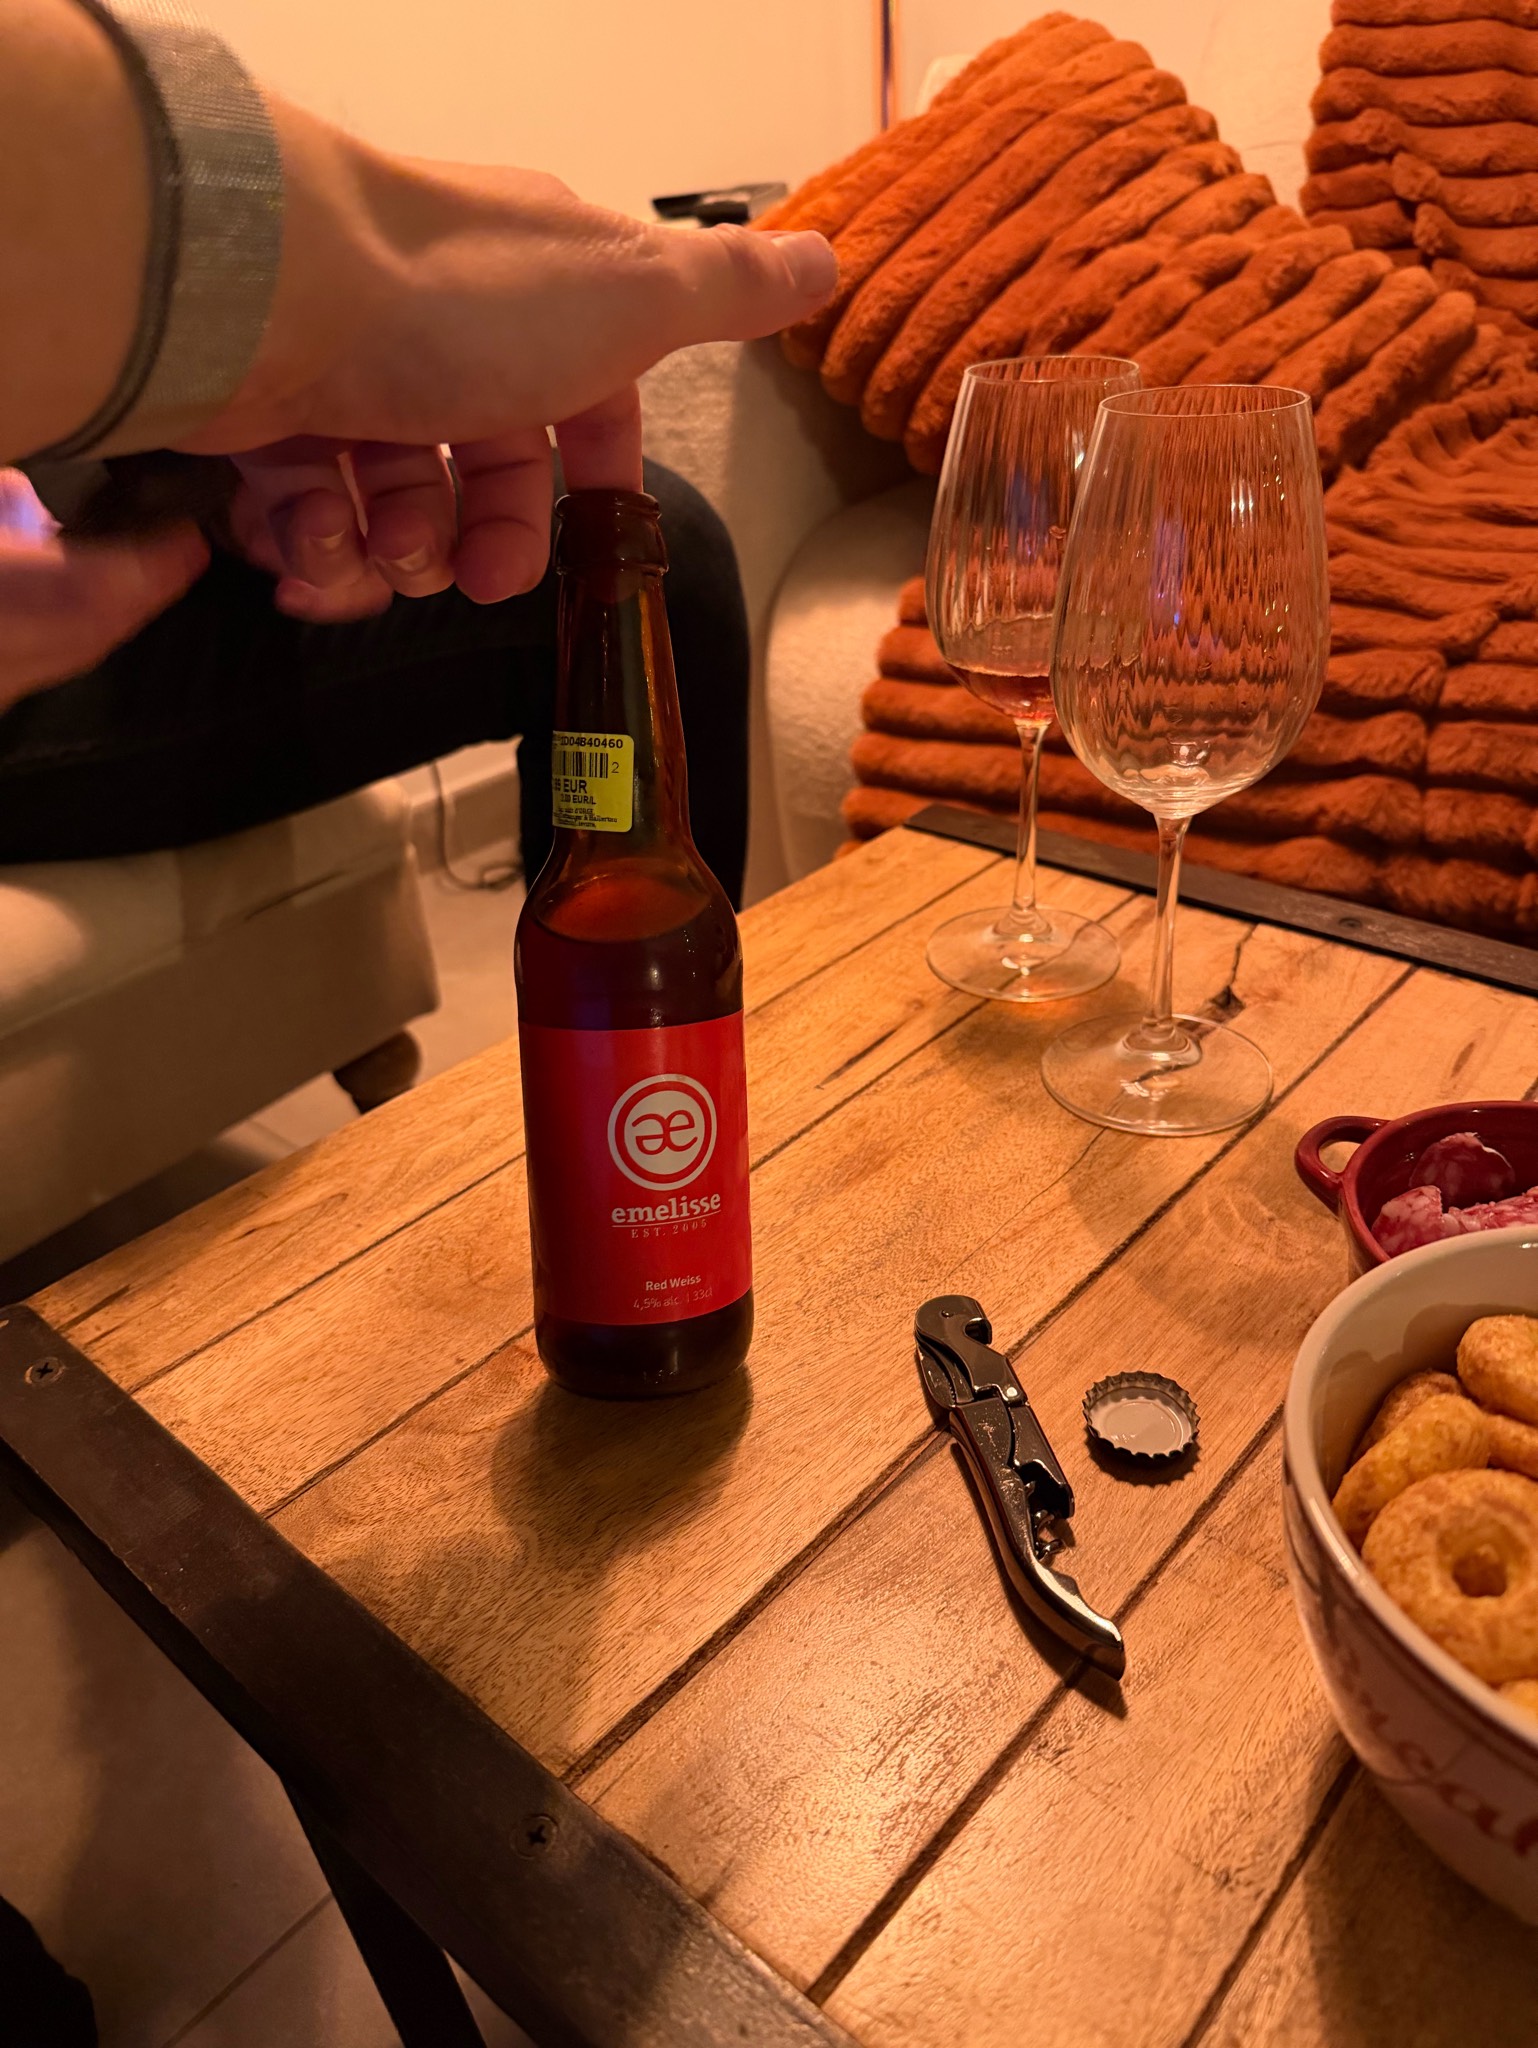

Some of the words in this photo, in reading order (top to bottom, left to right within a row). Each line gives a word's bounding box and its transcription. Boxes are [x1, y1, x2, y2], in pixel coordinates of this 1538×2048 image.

[611, 761, 620, 774] 2
[563, 778, 587, 794] EUR
[611, 1193, 722, 1224] emelisse
[631, 1227, 666, 1239] EST.
[672, 1218, 708, 1236] 2005
[645, 1279, 668, 1292] Red
[669, 1274, 702, 1289] Weiss
[633, 1297, 662, 1311] 4,5%
